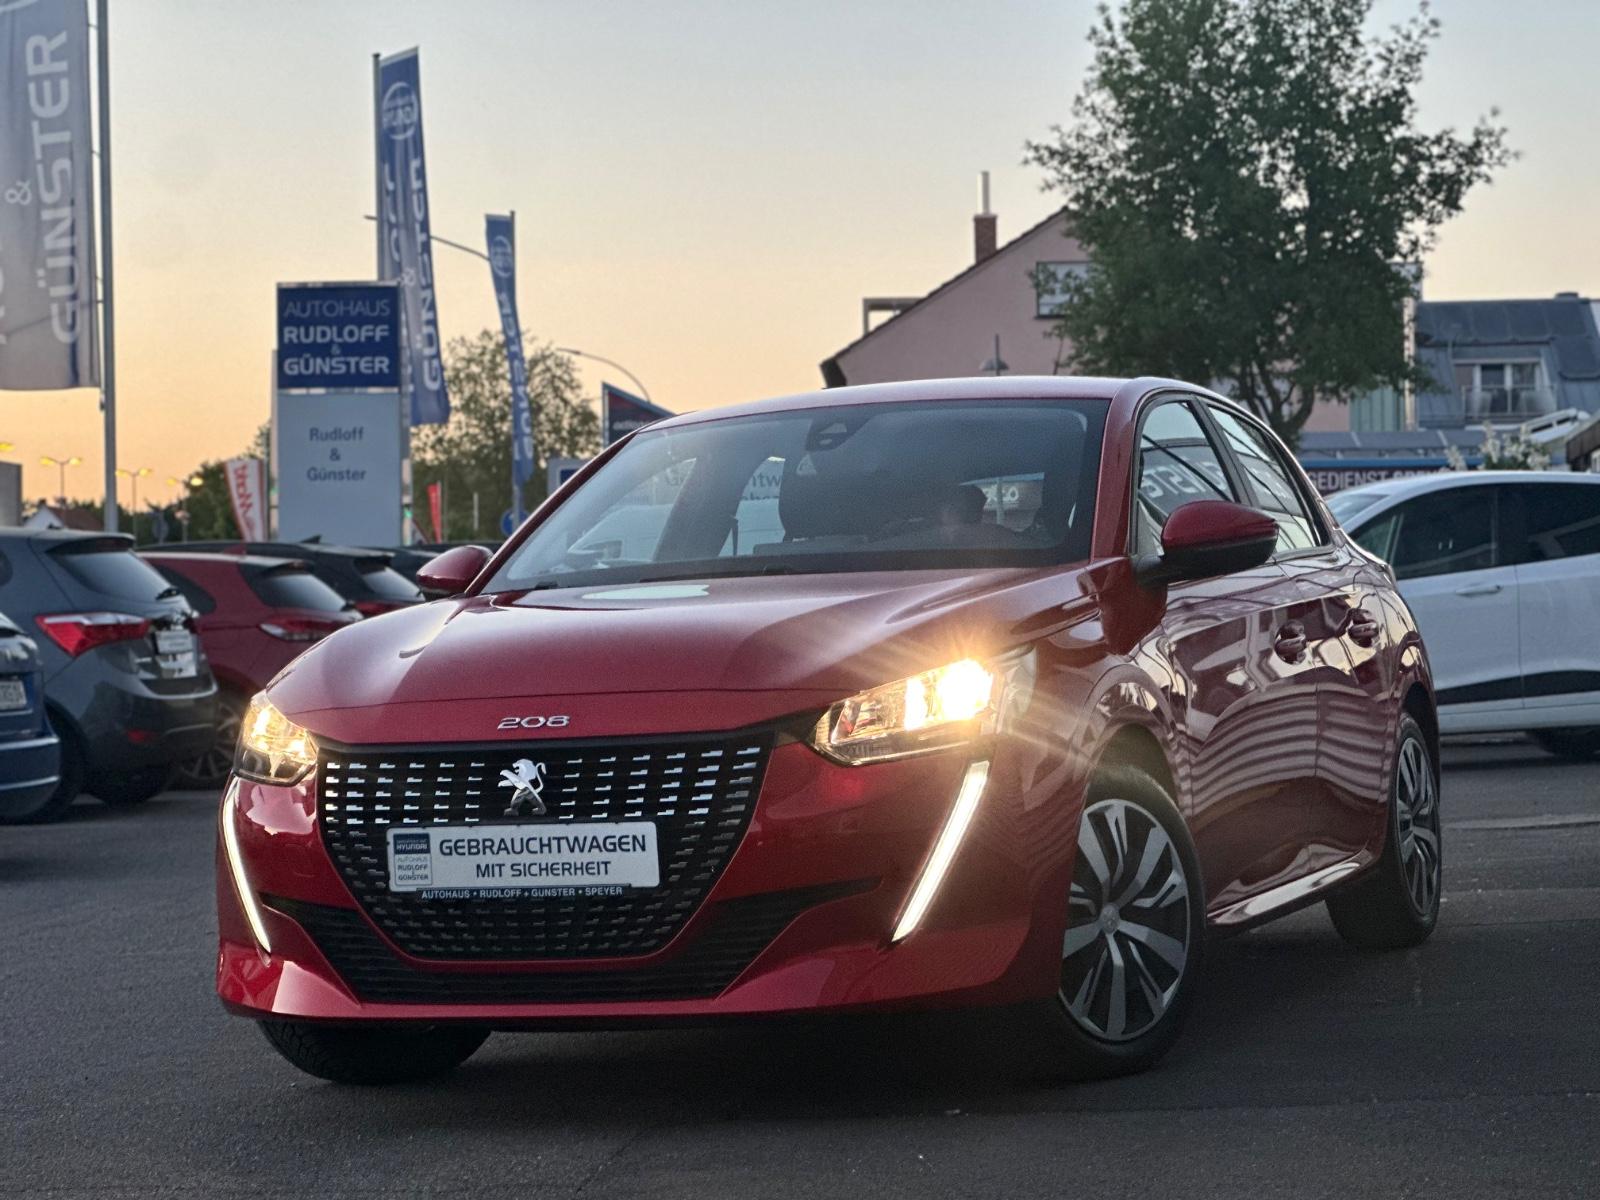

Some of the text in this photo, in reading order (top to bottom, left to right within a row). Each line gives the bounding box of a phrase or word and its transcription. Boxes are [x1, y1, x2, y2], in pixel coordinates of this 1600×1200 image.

[25, 30, 79, 345] GÜNSTER
[283, 299, 391, 318] AUTOHAUS
[283, 324, 390, 344] RUDLOFF
[283, 353, 390, 375] GÜNSTER
[309, 426, 364, 442] Rudloff
[329, 447, 341, 461] &
[306, 466, 367, 481] Günster
[497, 715, 570, 731] 208
[439, 834, 647, 857] GEBRAUCHTWAGEN
[476, 861, 612, 879] MIT SICHERHEIT
[421, 889, 470, 899] AUTOHAUS
[480, 888, 522, 898] RUDLOFF
[585, 886, 623, 896] SPEYER
